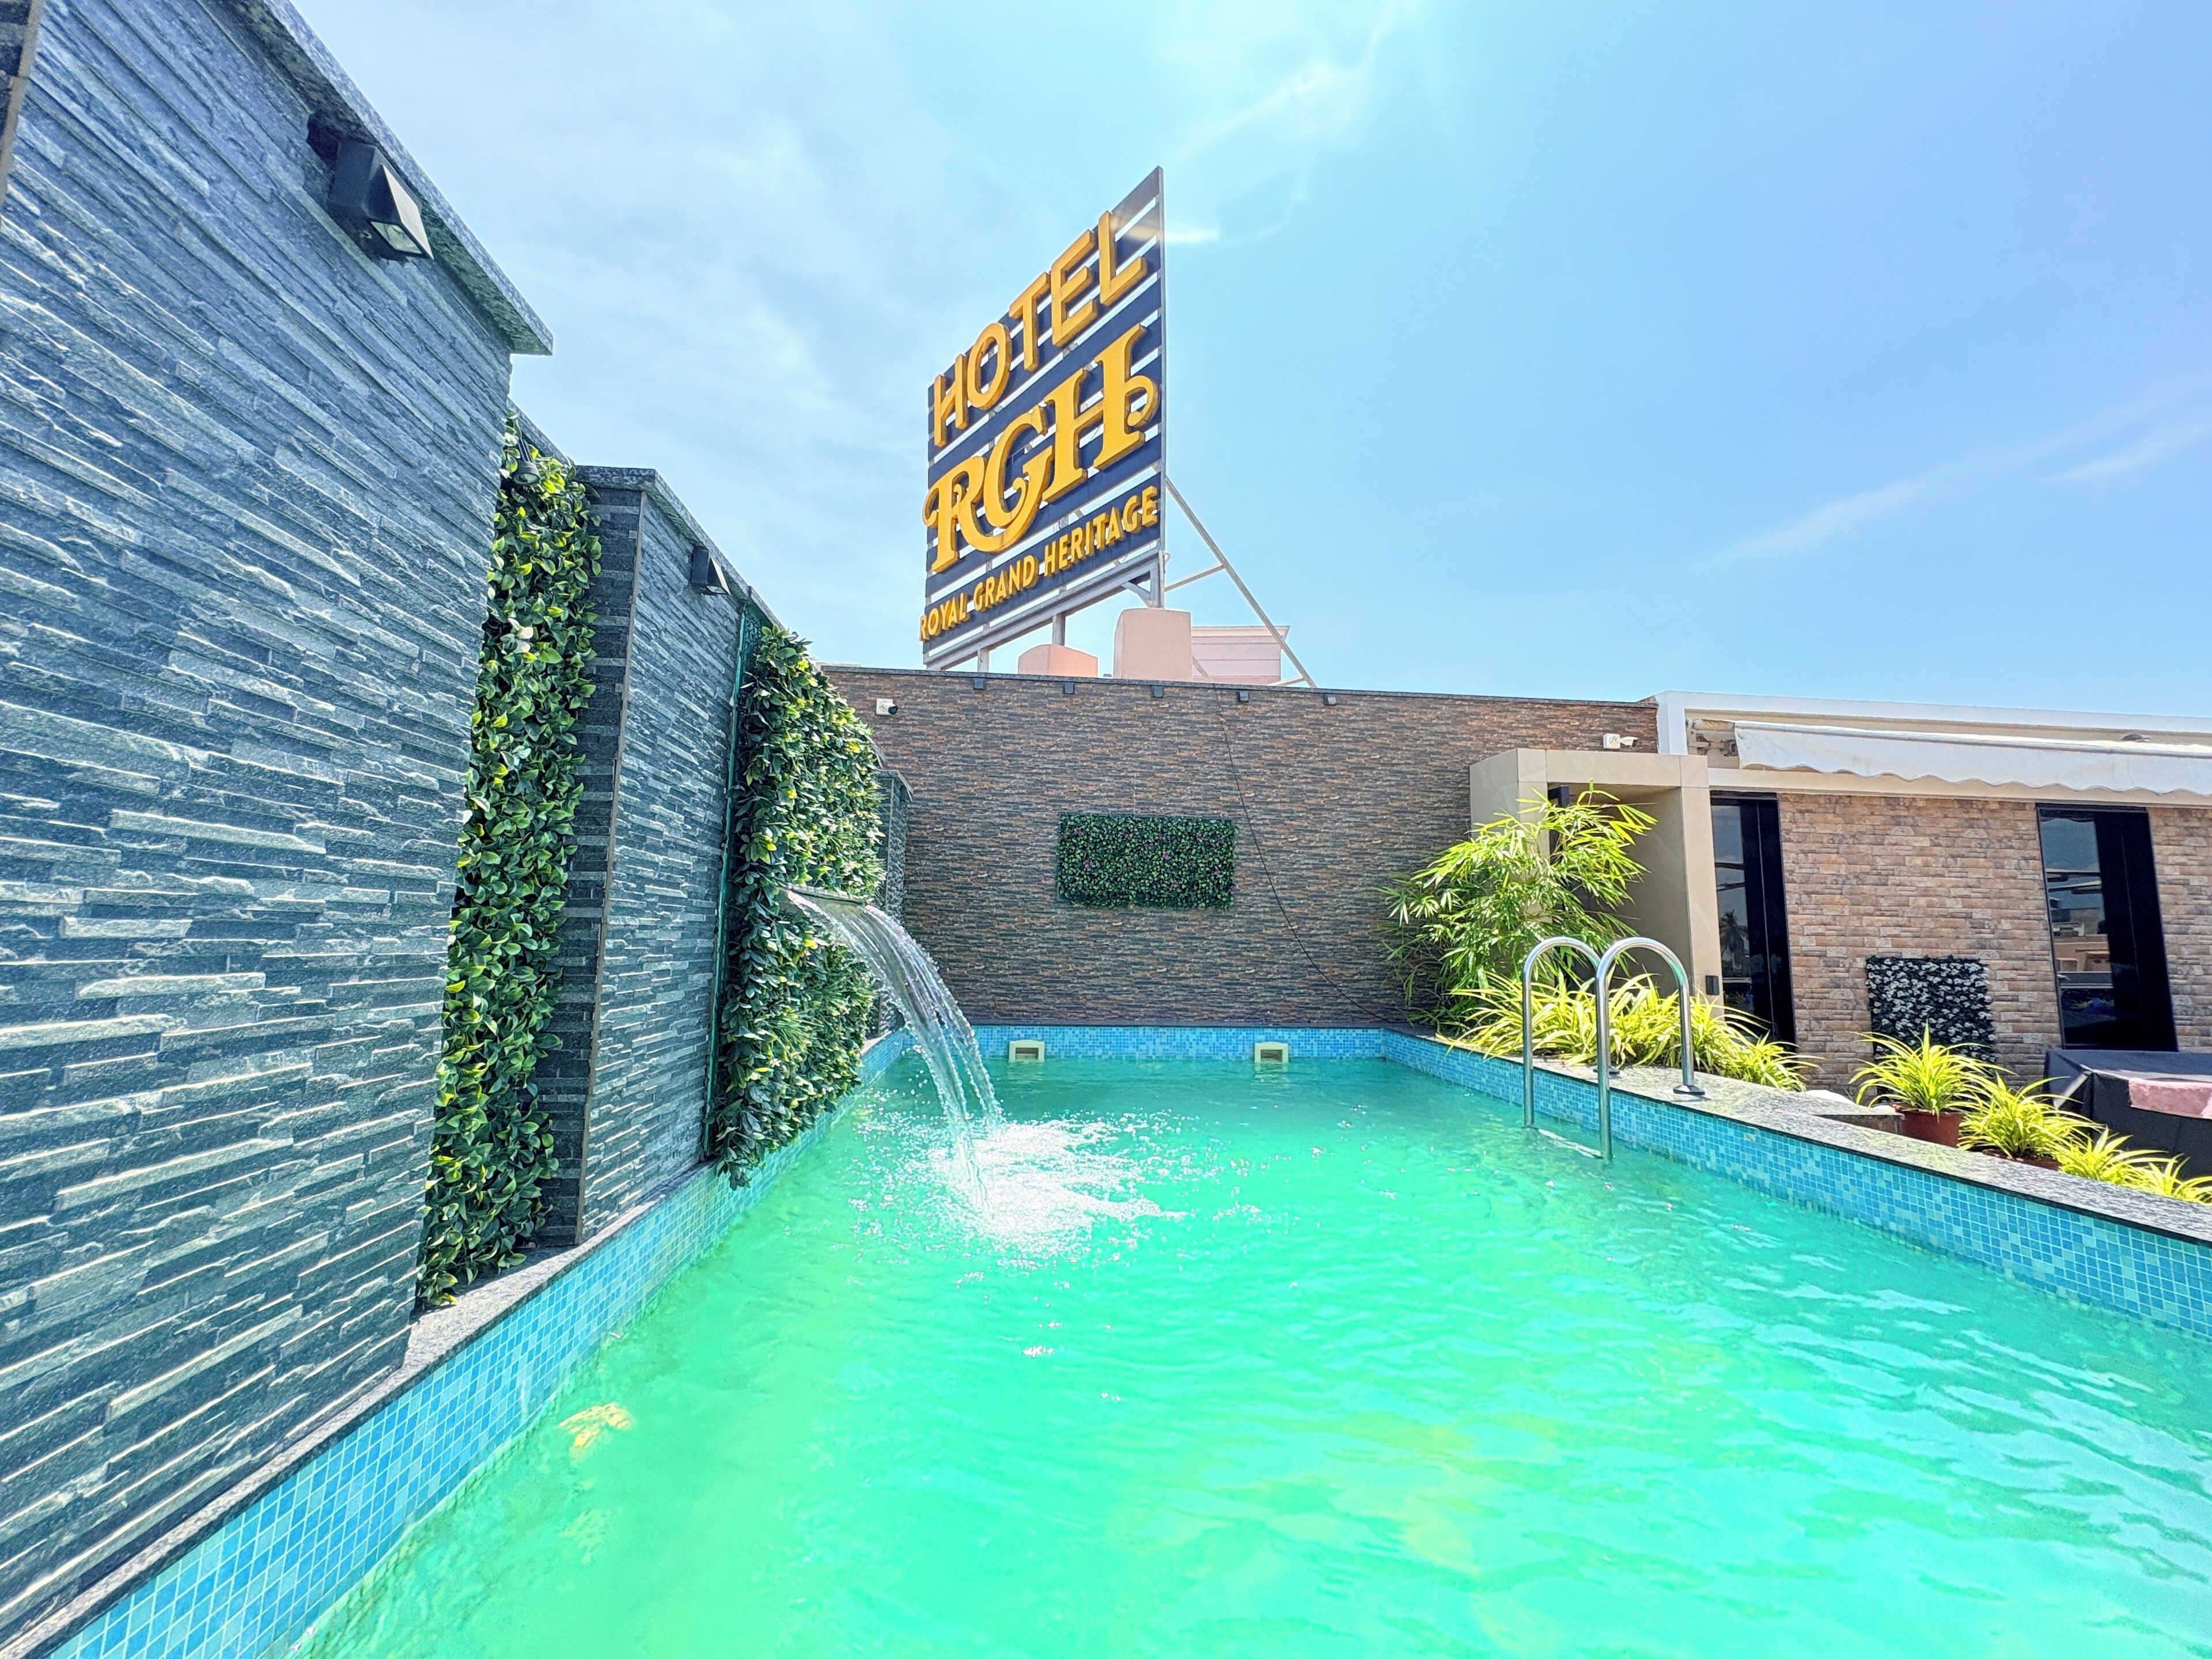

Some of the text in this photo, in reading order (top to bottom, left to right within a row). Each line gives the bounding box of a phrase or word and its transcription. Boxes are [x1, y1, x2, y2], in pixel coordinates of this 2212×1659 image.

[933, 210, 1147, 447] HOTEL
[920, 486, 1158, 641] ROYAL GRAND HERITAGE
[923, 323, 1159, 572] RGH
